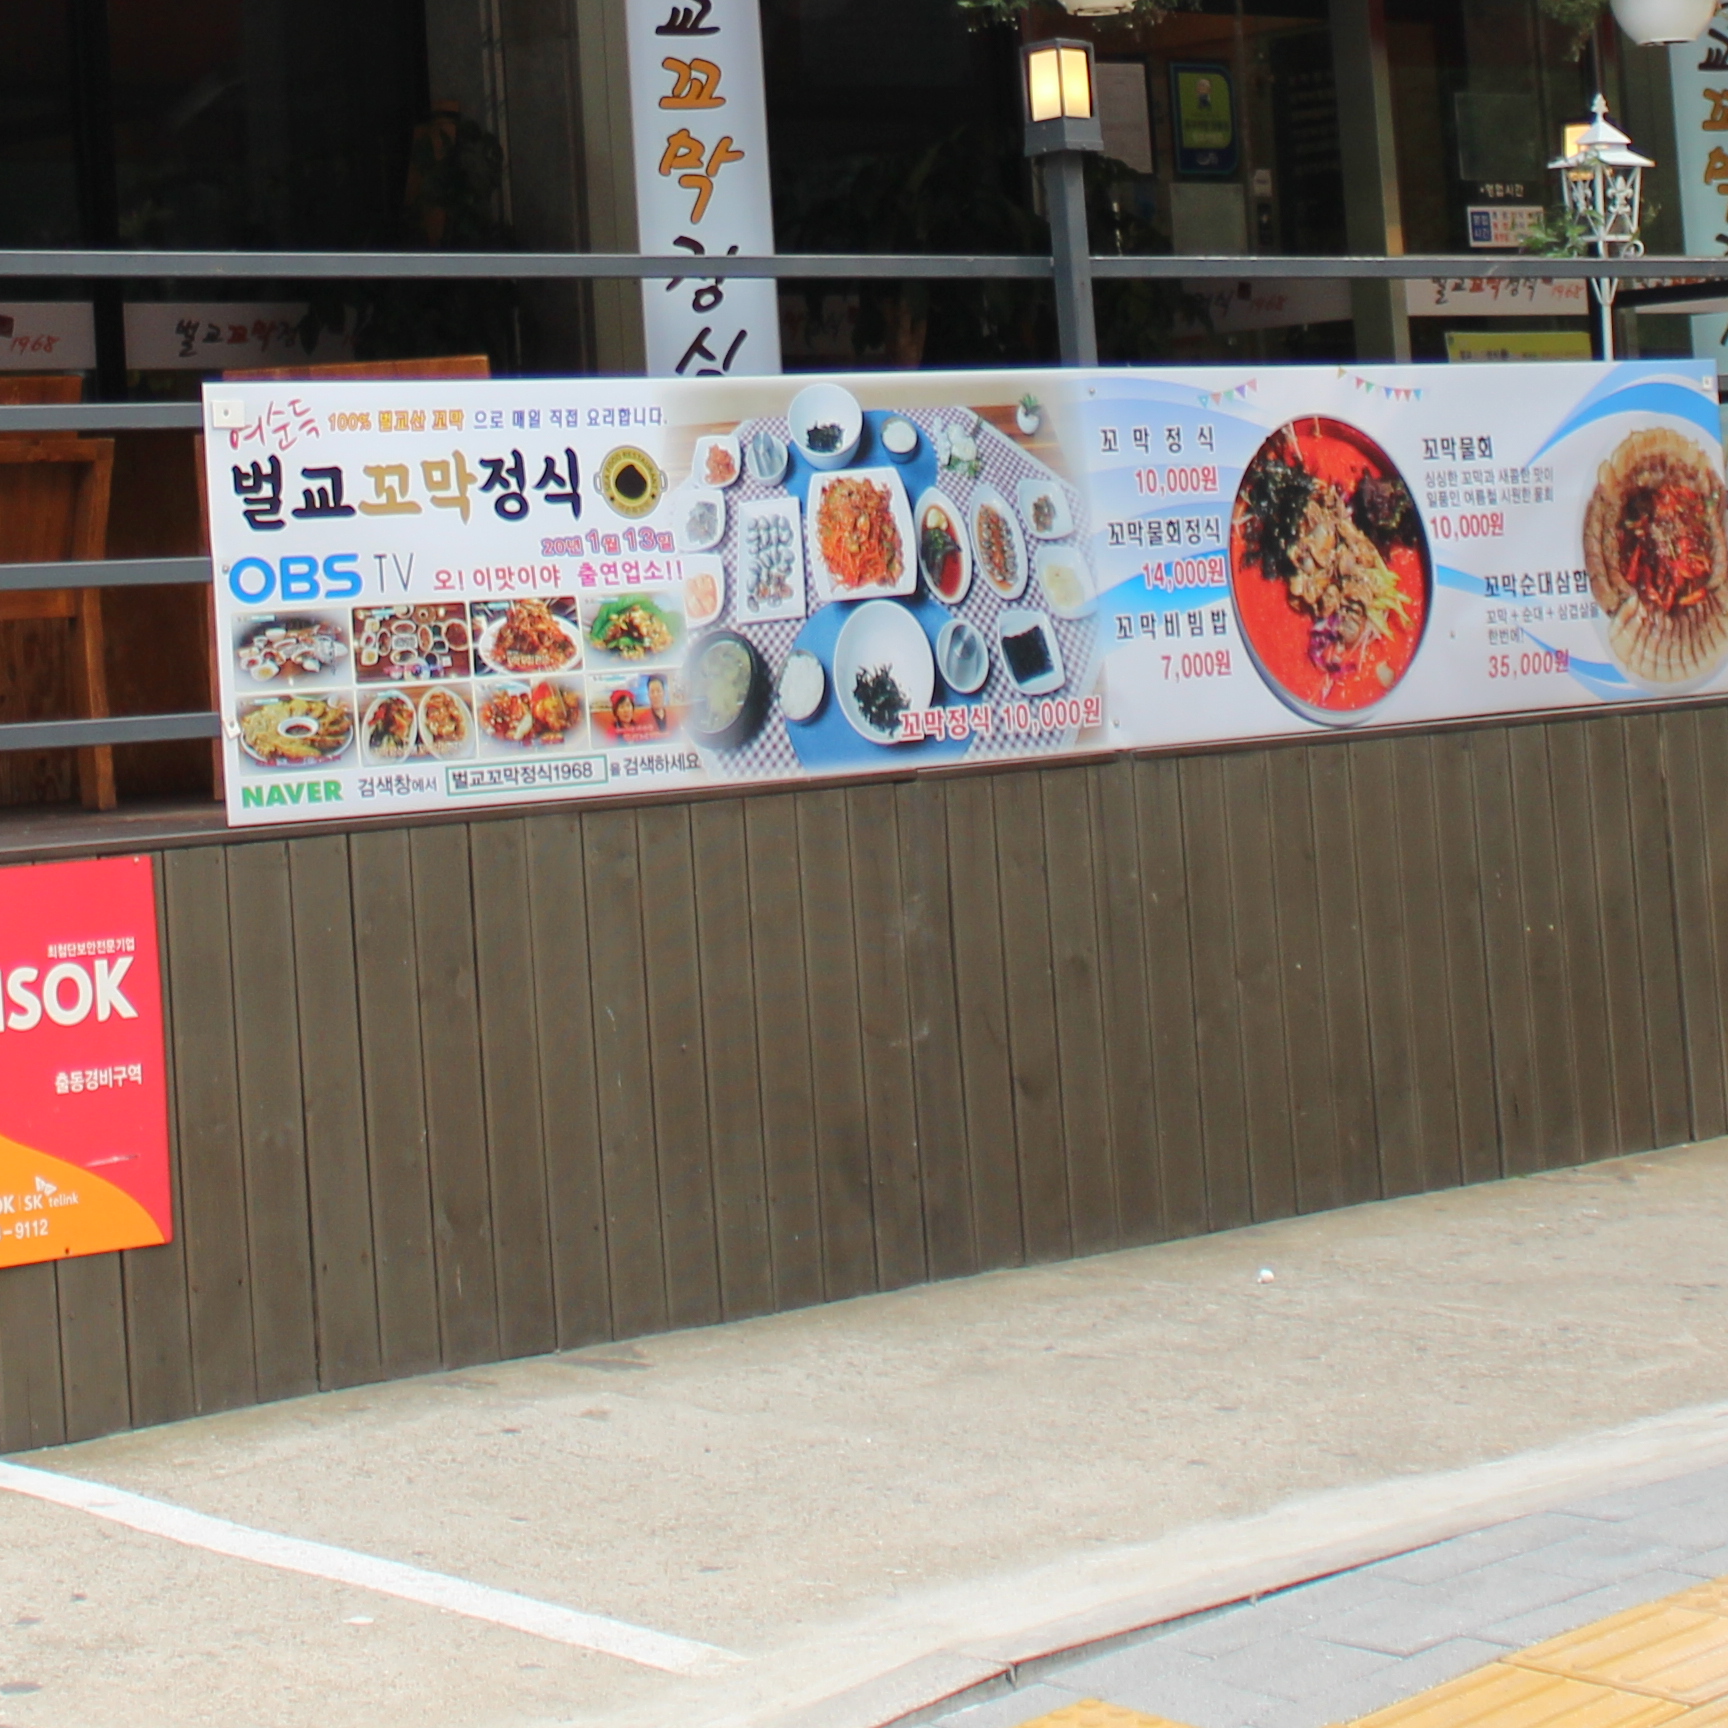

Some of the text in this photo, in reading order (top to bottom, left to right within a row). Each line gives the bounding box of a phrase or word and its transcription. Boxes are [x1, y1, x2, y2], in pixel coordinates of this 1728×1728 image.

[8, 333, 61, 354] 1968
[229, 398, 321, 452] 여순득
[327, 411, 373, 433] 100%
[378, 410, 428, 433] 벌교산
[512, 409, 542, 429] 매일
[548, 408, 579, 429] 직접
[586, 406, 669, 427] 요리합니다.
[1422, 435, 1494, 462] 꼬막물회
[231, 445, 583, 532] 벌교꼬막정식
[1133, 465, 1219, 496] 10,000원
[1425, 470, 1458, 489] 싱싱한
[1461, 469, 1495, 486] 꼬막과
[1533, 467, 1554, 484] 맛이
[1426, 486, 1554, 508] 일품인 여름철 시원한 물회
[541, 526, 677, 557] 20년 1월 13일
[1107, 515, 1222, 547] 꼬막물회정식
[1429, 512, 1505, 541] 10,000원
[228, 551, 684, 604] OBS TV 오! 이맛이야 출연업소!!
[1141, 556, 1226, 590] 14,000원
[1484, 569, 1589, 599] 꼬막순대삼합
[1115, 608, 1229, 641] 꼬막비빔밥
[1486, 608, 1508, 625] 꼬막
[1522, 606, 1544, 623] 순대
[1160, 648, 1233, 681] 7,000원
[1487, 647, 1570, 681] 35,000원
[900, 695, 1103, 742] 꼬막정식 10,000원
[241, 779, 343, 809] NAVER
[357, 774, 438, 799] 검색창에서
[451, 760, 595, 791] 벌교꼬막정식1968
[622, 752, 700, 774] 검색하세요
[47, 936, 136, 960] 최첨단보안전문기업
[54, 1063, 142, 1096] 출동경비구역
[24, 1190, 43, 1212] SK
[48, 1188, 80, 1208] telink
